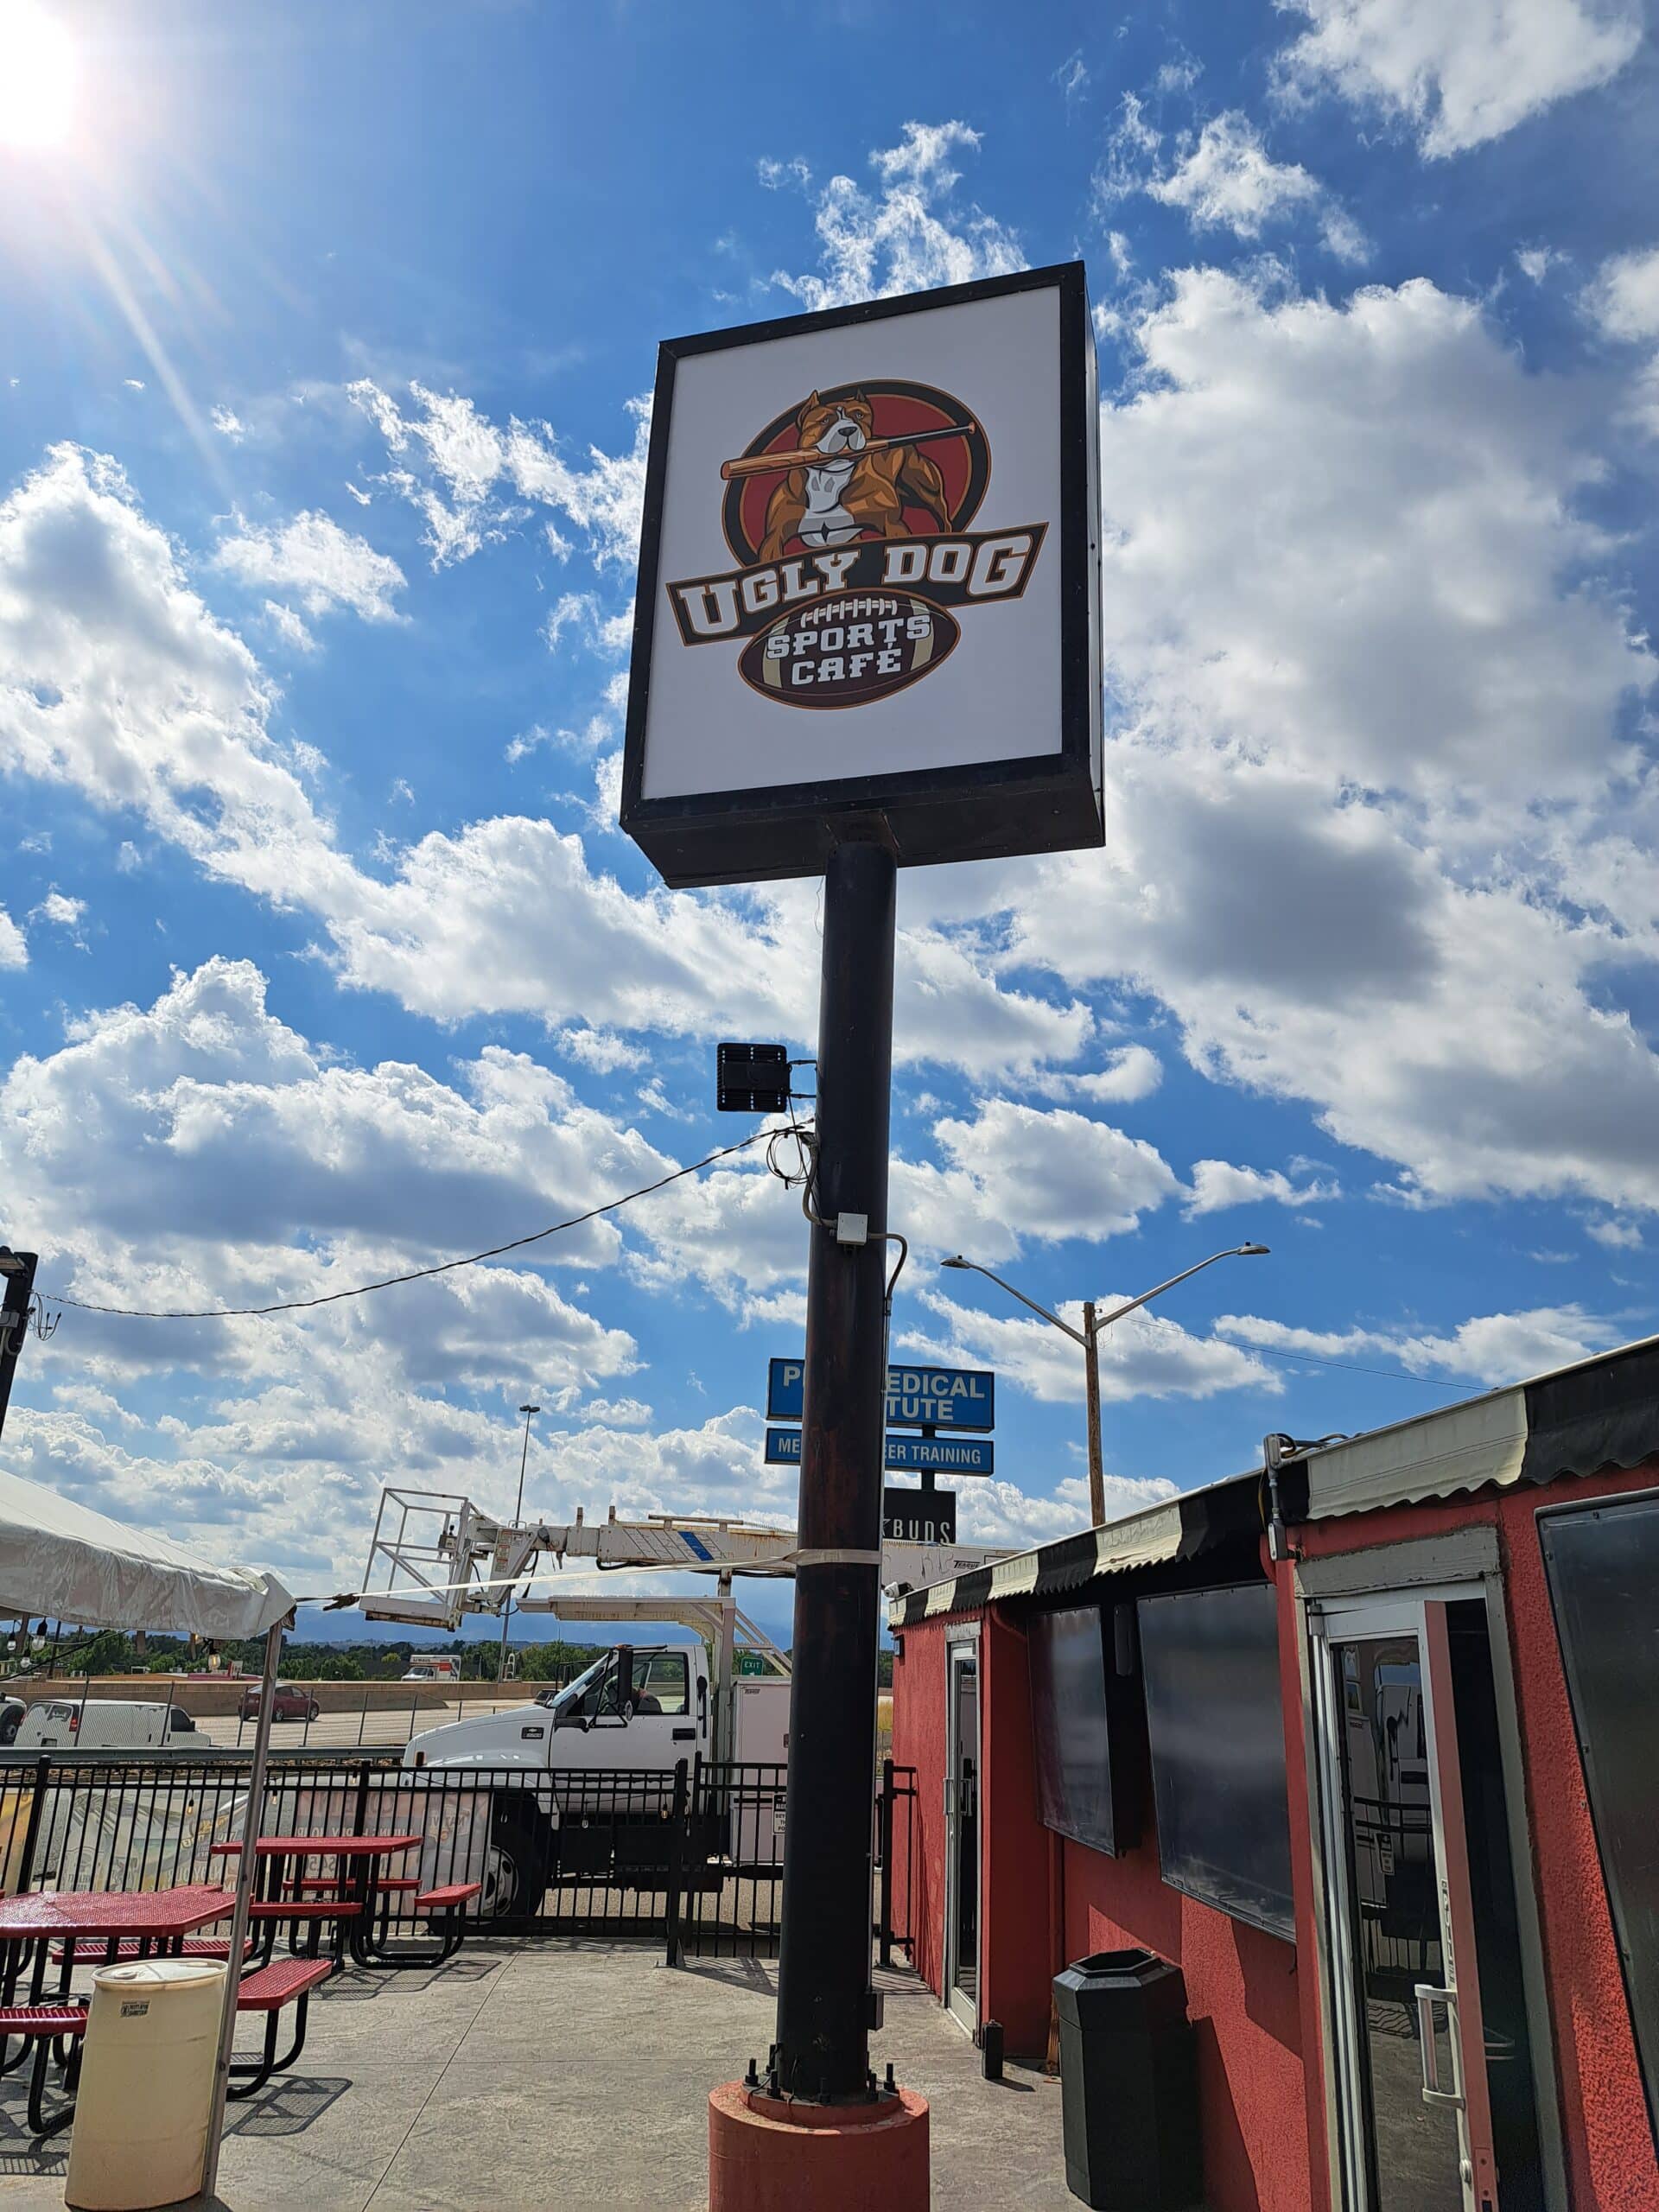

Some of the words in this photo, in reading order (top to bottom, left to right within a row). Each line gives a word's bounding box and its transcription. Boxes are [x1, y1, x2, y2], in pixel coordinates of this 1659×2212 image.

[678, 550, 861, 635] UGLY
[882, 535, 1033, 595] DOG
[766, 614, 931, 659] SPORTS
[885, 1372, 985, 1398] EDICAL
[887, 1396, 954, 1421] TUTE
[912, 1446, 982, 1465] TRAINING
[744, 1661, 761, 1669] EXIT
